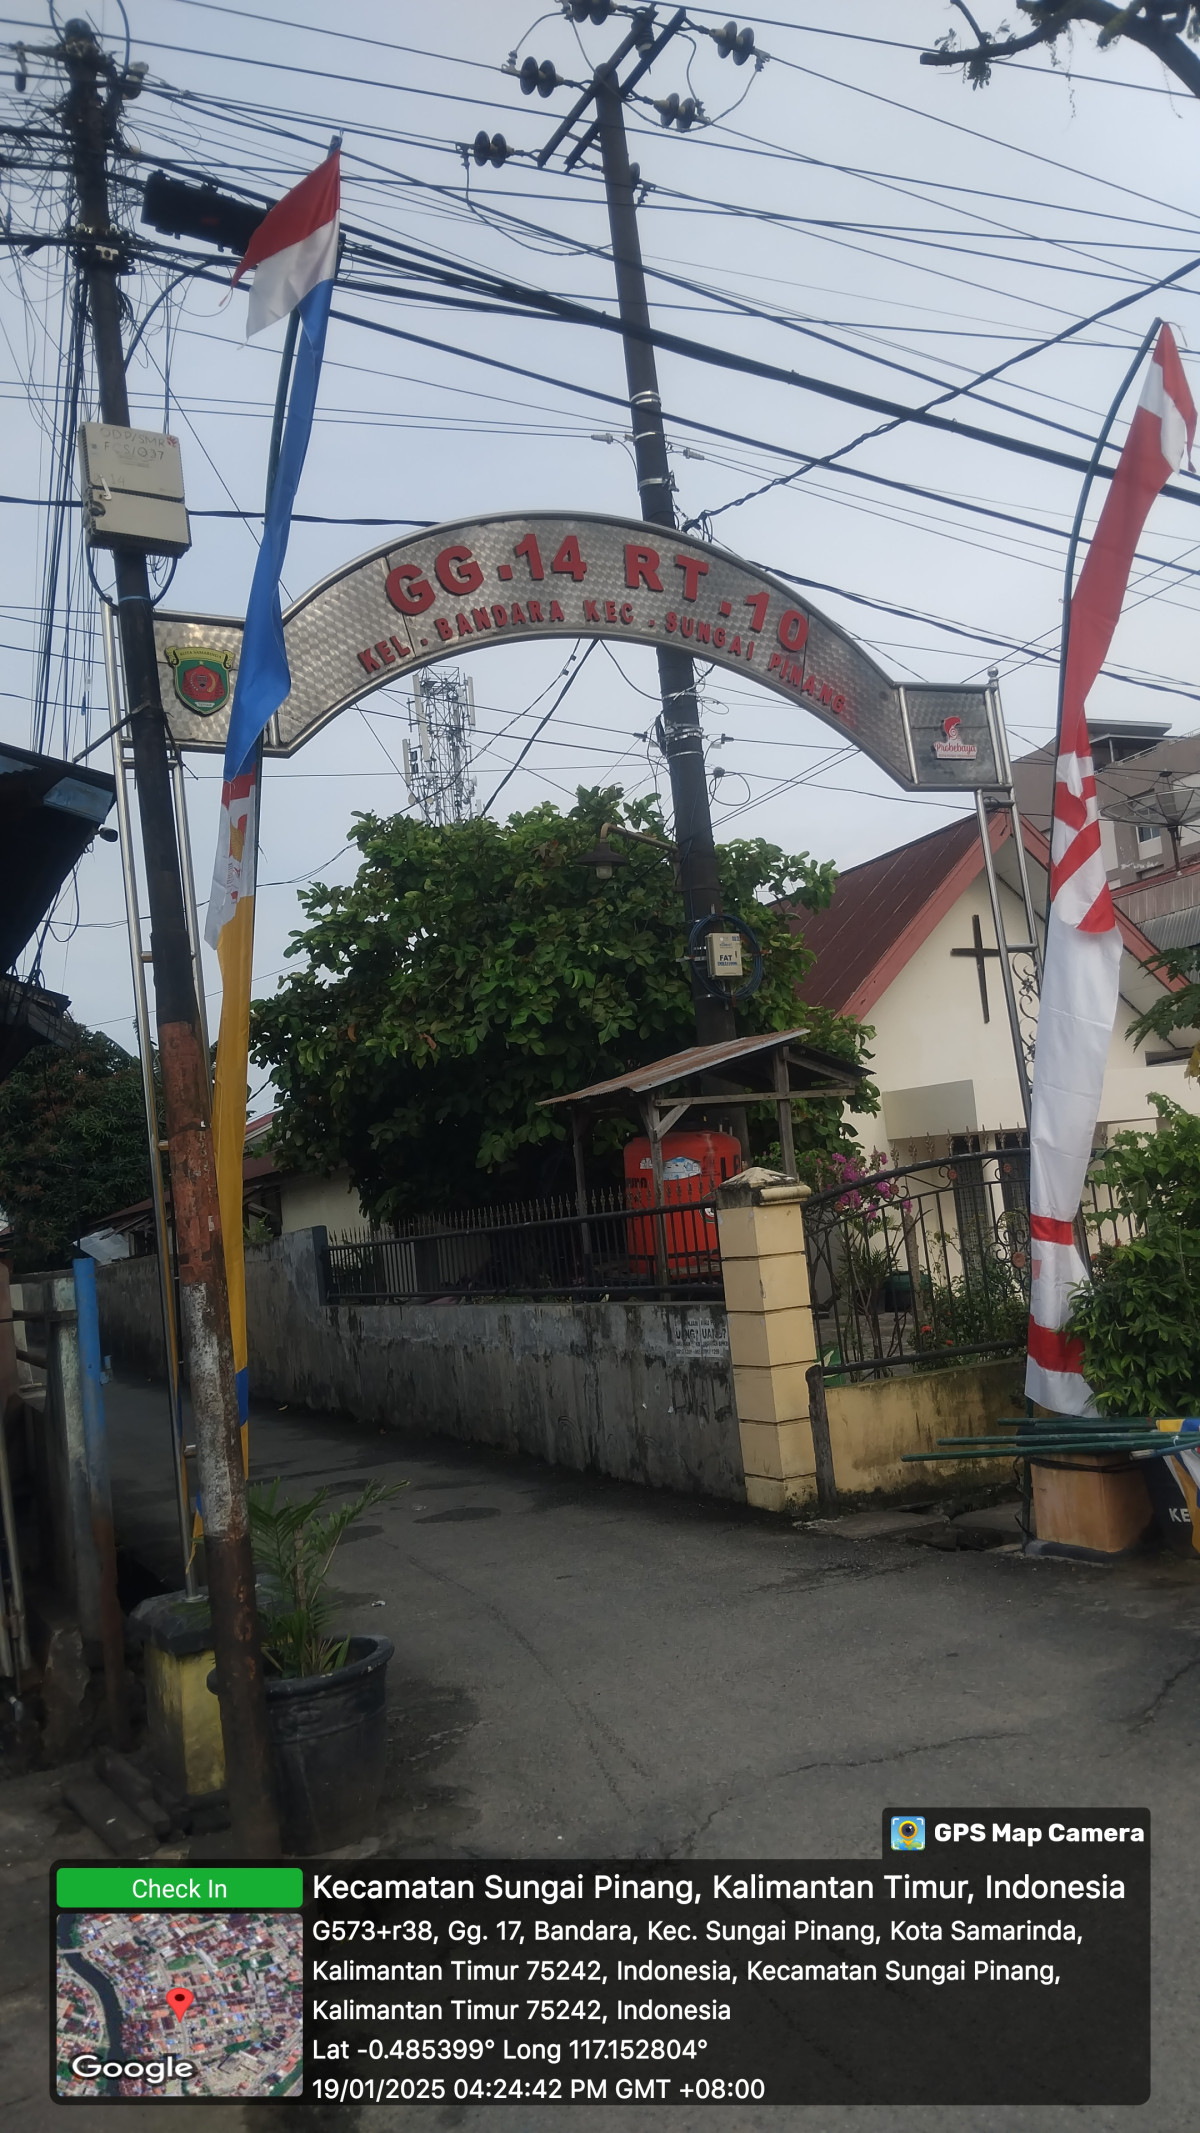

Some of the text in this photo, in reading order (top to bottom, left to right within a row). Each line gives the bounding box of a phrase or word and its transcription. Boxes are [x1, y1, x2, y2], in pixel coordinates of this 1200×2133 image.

[434, 599, 565, 641] BANDARA
[665, 611, 755, 660] SUNGAI
[768, 652, 847, 715] PINANG
